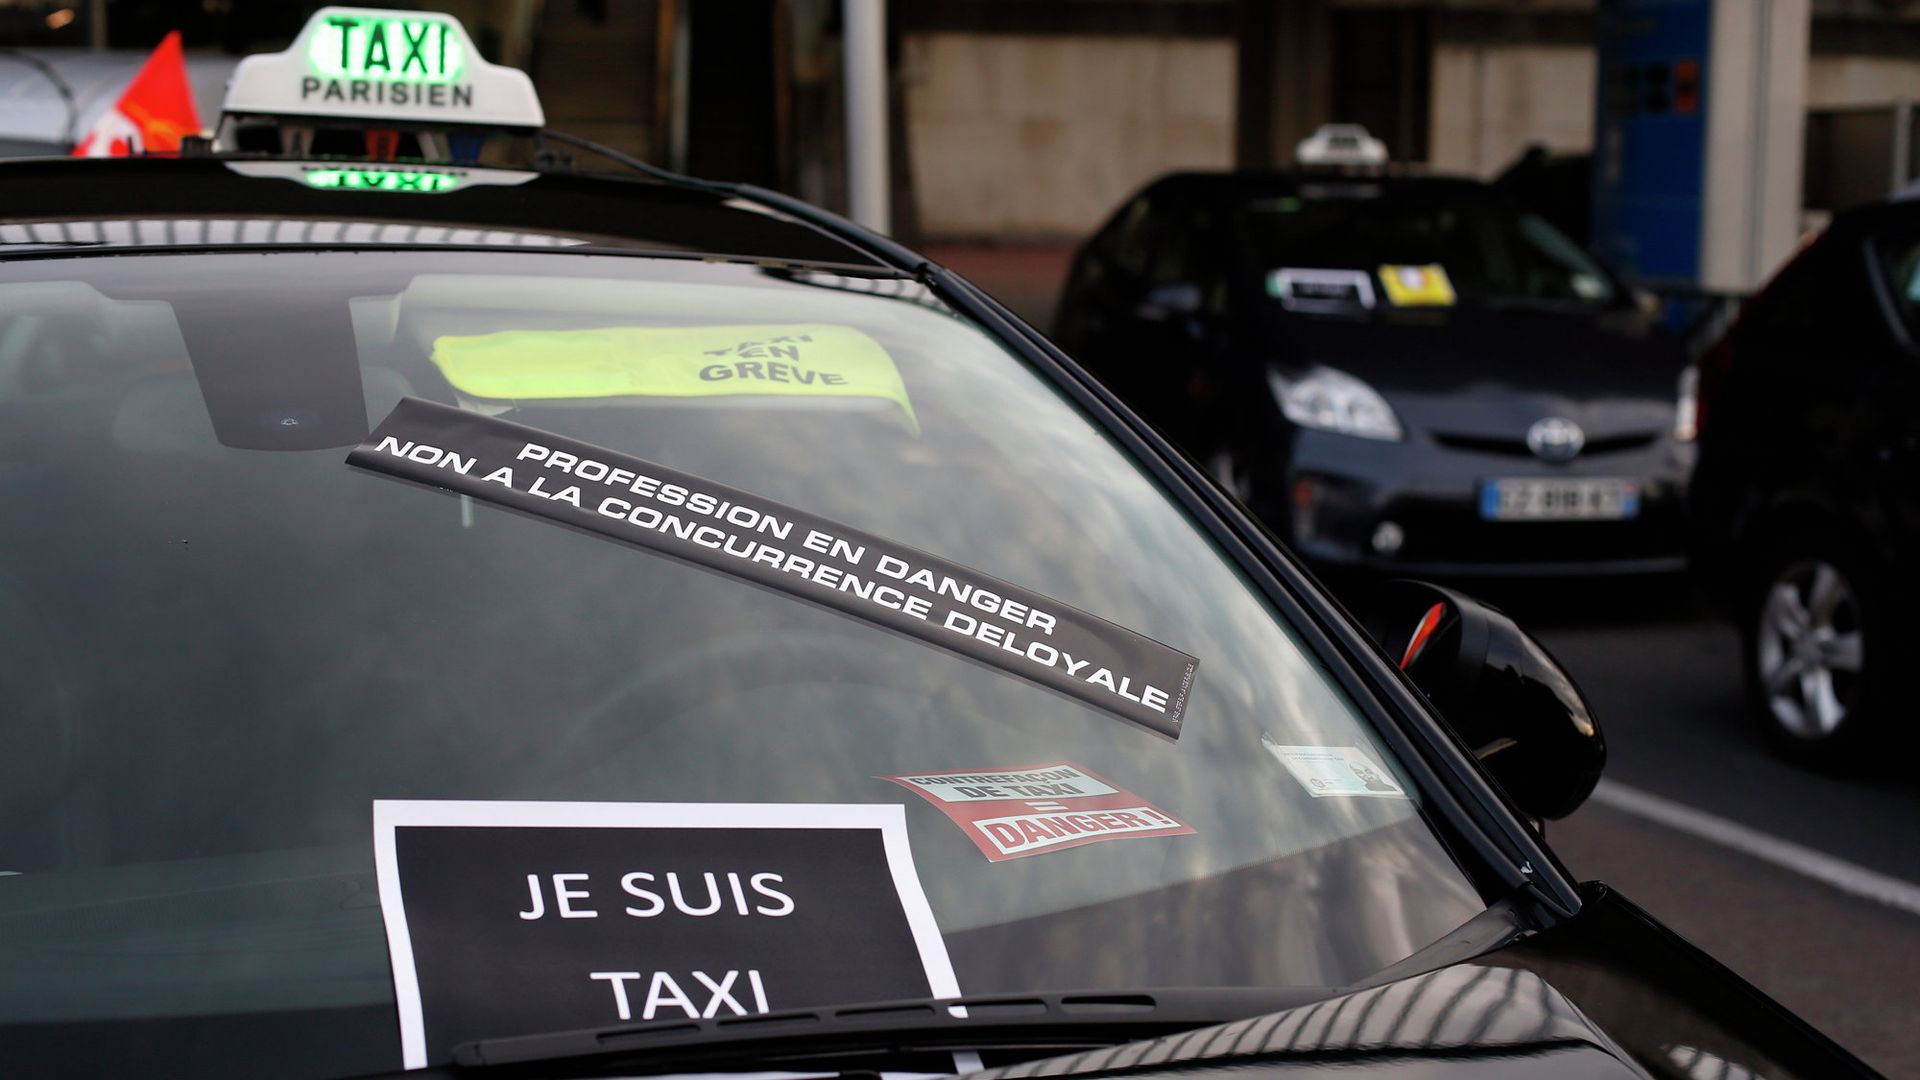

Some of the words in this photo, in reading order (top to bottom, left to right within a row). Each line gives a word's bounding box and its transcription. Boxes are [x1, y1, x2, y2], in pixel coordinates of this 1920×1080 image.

[328, 18, 447, 74] TAXI
[302, 79, 473, 106] PARISIEN
[738, 345, 799, 361] EN
[699, 361, 848, 385] GREVE
[516, 443, 792, 538] PROFESSION
[805, 529, 865, 565] EN
[876, 554, 1057, 635] DANGER
[375, 436, 477, 475] NON
[482, 467, 513, 488] A
[528, 477, 582, 507] LA
[597, 497, 933, 621] CONCURRENCE
[943, 611, 1169, 713] DELOYALE
[908, 768, 1081, 786] CONTREFAÇON
[953, 785, 1010, 799] DE
[1010, 782, 1084, 798] TAXI
[984, 813, 1147, 849] DANGER
[519, 872, 597, 920] JE
[620, 871, 796, 917] SUIS
[590, 970, 770, 1020] TAXI
